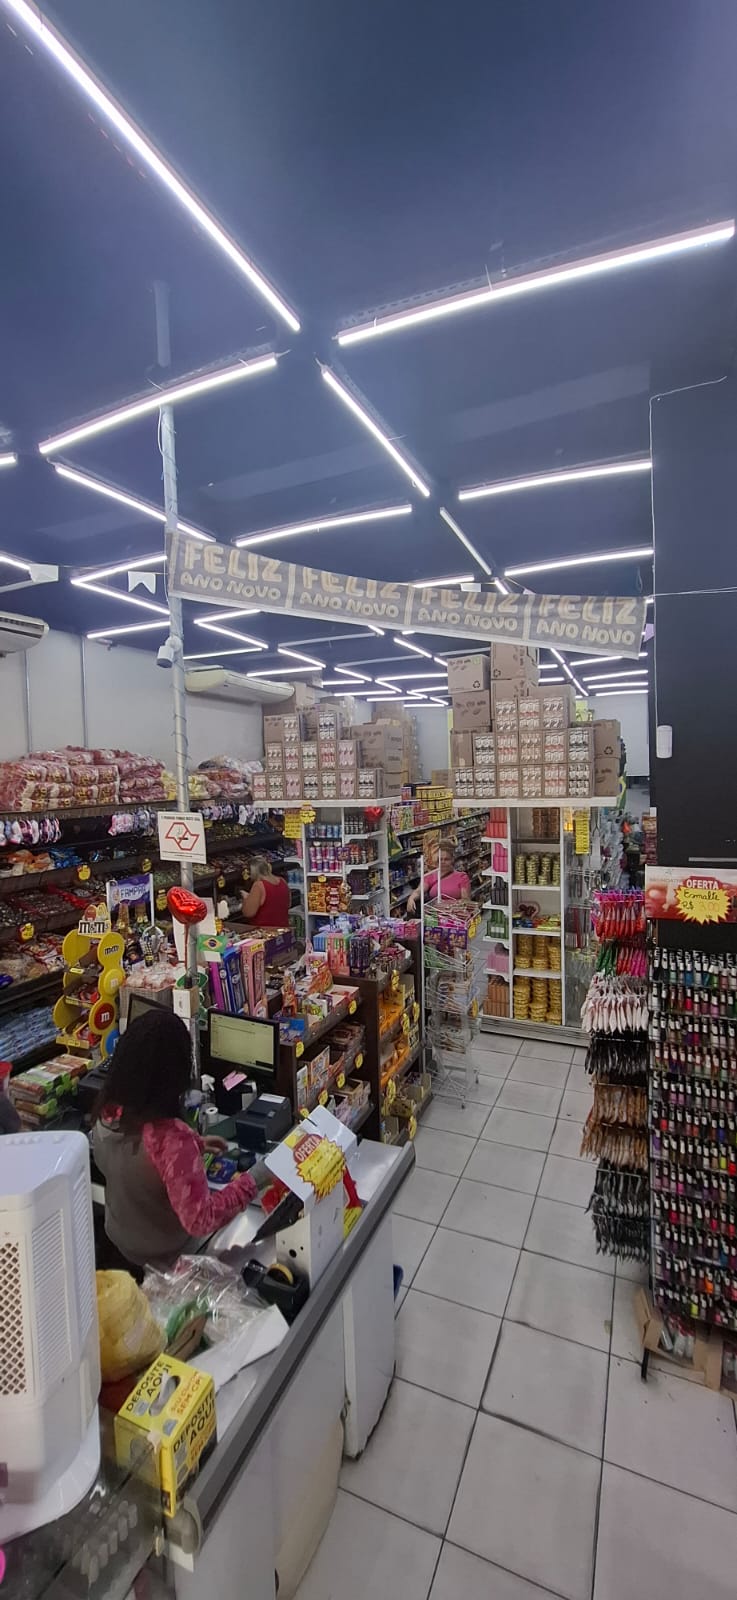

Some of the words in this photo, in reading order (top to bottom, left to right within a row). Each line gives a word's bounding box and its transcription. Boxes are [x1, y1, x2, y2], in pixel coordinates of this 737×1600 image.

[184, 540, 282, 582] FELIZ
[180, 571, 223, 591] ANO
[226, 580, 281, 600] NOVO
[302, 566, 401, 599] FELIZ
[299, 591, 343, 610] ANO
[345, 598, 399, 618] NOVO
[539, 594, 637, 625] FELIZ
[417, 607, 461, 624] ANO
[464, 614, 518, 631] NOVO
[536, 618, 579, 639] ANO
[581, 625, 636, 646] NOVO
[683, 890, 721, 901] Esmalte
[686, 879, 719, 891] OFERTA
[294, 1136, 321, 1161] OFERTA
[126, 1360, 165, 1412] DEPOSITE
[190, 1399, 215, 1446] AQUI
